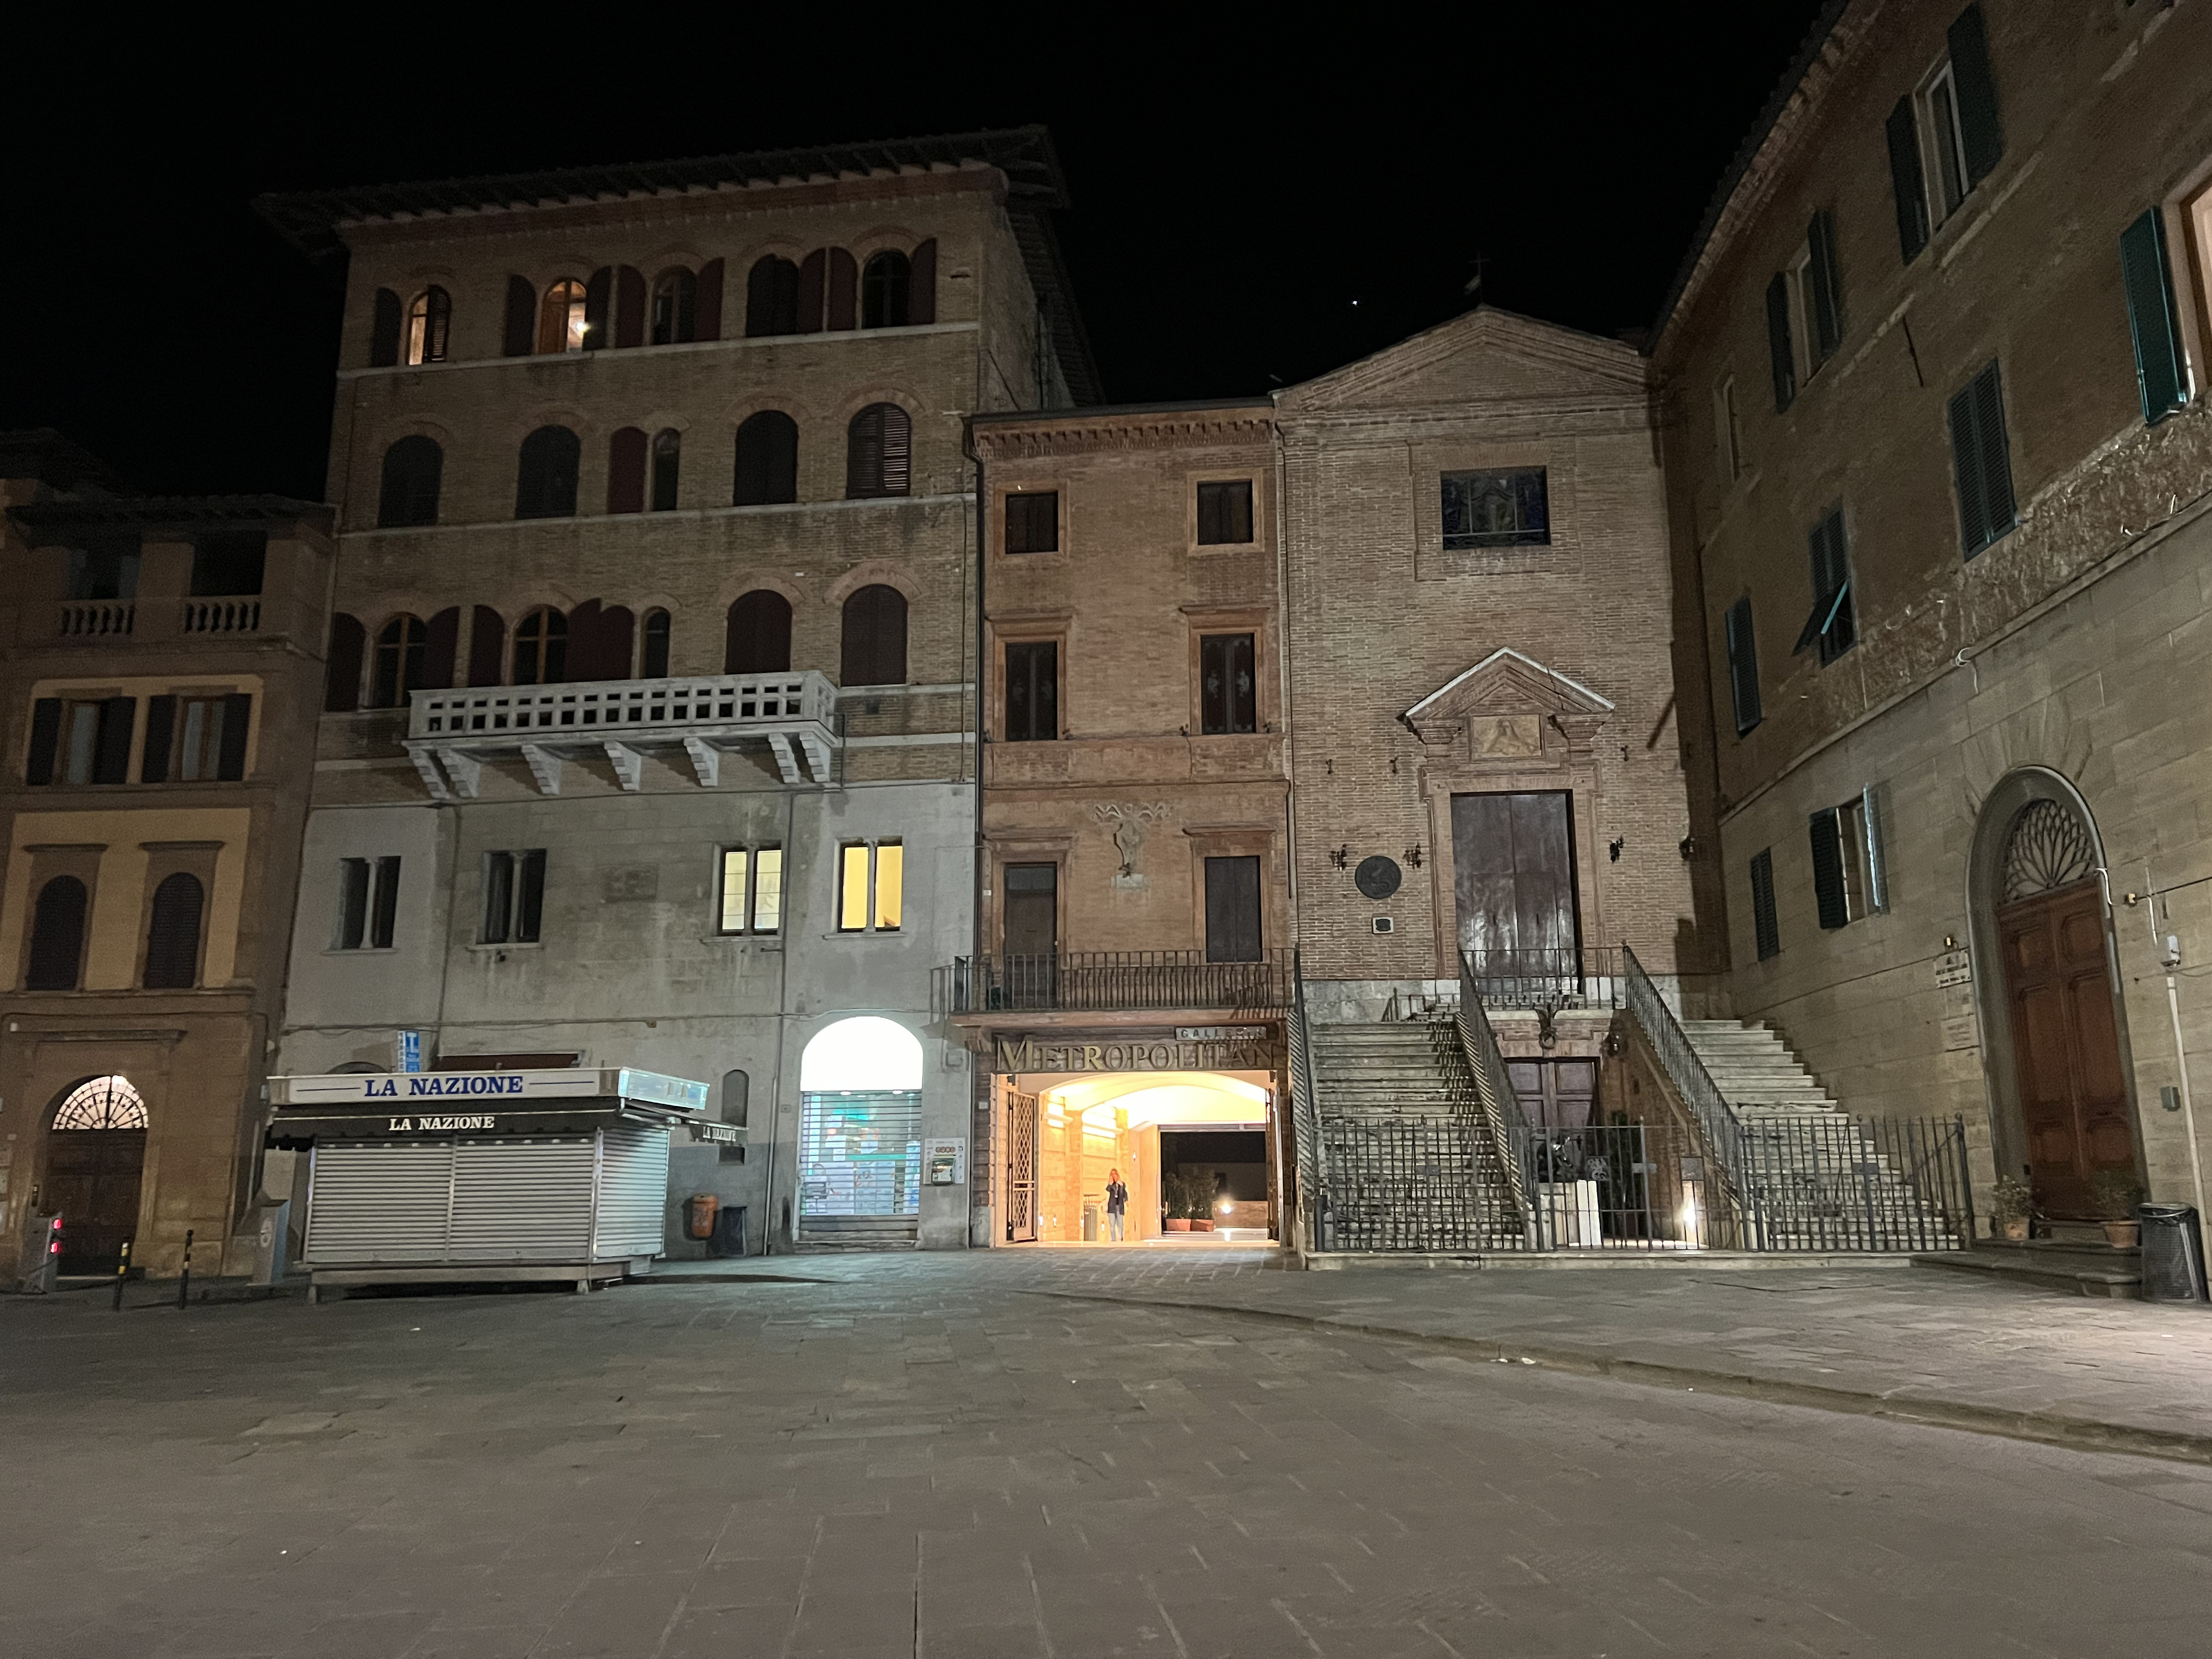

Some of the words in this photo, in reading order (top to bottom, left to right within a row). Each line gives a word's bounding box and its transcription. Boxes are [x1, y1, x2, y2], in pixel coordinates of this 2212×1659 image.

[364, 1079, 398, 1097] LA
[409, 1076, 523, 1095] NAZIONE
[389, 1118, 411, 1131] LA
[419, 1116, 495, 1130] NAZIONE
